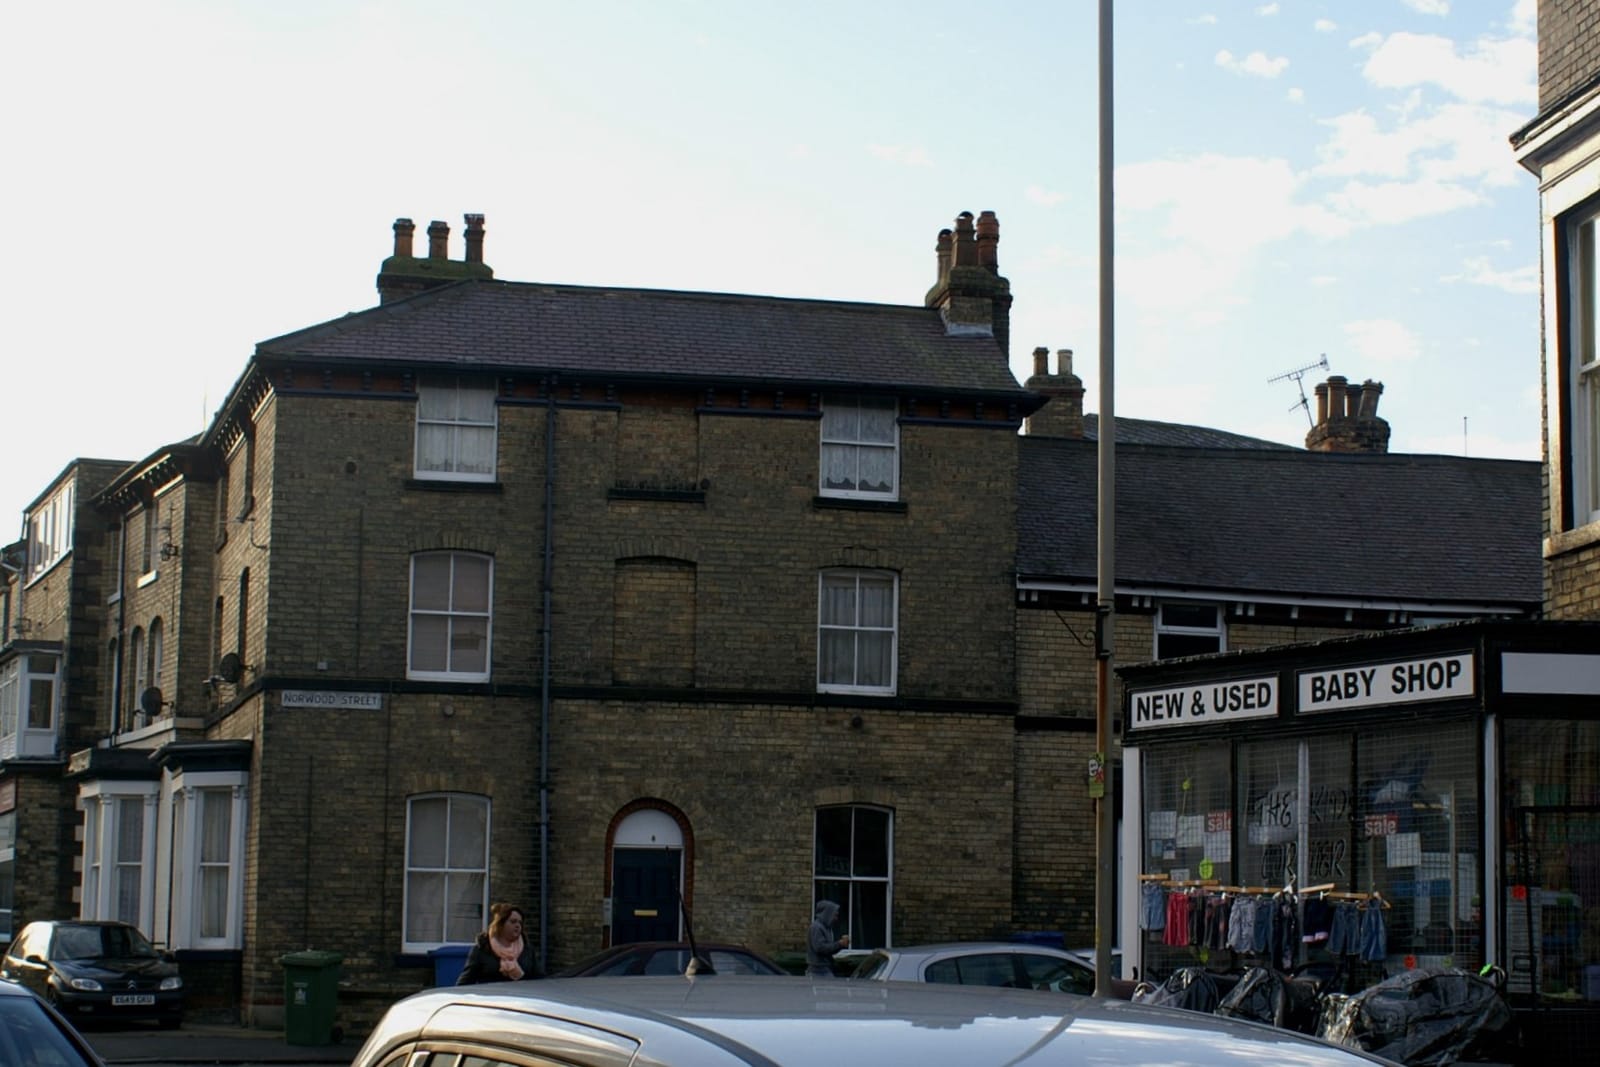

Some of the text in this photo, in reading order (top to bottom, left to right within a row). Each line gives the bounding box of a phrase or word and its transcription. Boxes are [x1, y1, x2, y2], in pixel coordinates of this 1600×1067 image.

[1311, 659, 1461, 703] BABY SHOP
[284, 693, 378, 706] NORWOOD STREET
[1136, 682, 1272, 722] NEW & USED
[1364, 814, 1397, 836] sale
